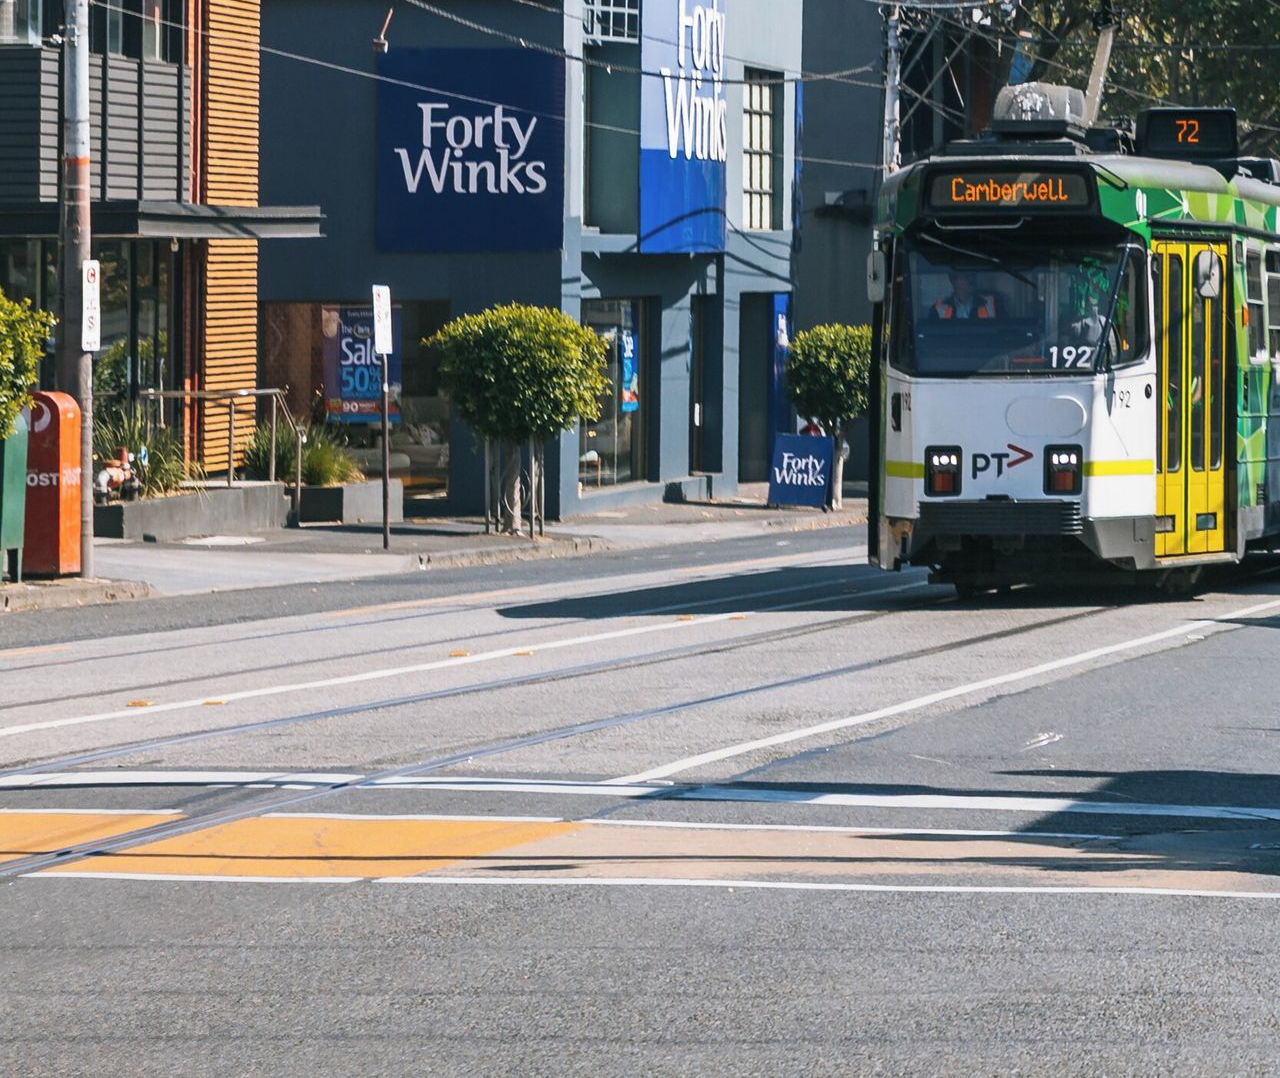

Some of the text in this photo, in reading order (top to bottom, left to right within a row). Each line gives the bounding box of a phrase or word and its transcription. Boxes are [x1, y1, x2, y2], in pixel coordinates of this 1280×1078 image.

[660, 67, 727, 163] Winks
[416, 102, 538, 160] Forty
[1175, 119, 1200, 143] 72
[393, 147, 548, 195] Winks
[951, 178, 1069, 202] Camberwell
[1050, 346, 1092, 368] 192
[782, 452, 825, 472] Forty
[26, 473, 60, 487] OST
[774, 467, 825, 486] Winks
